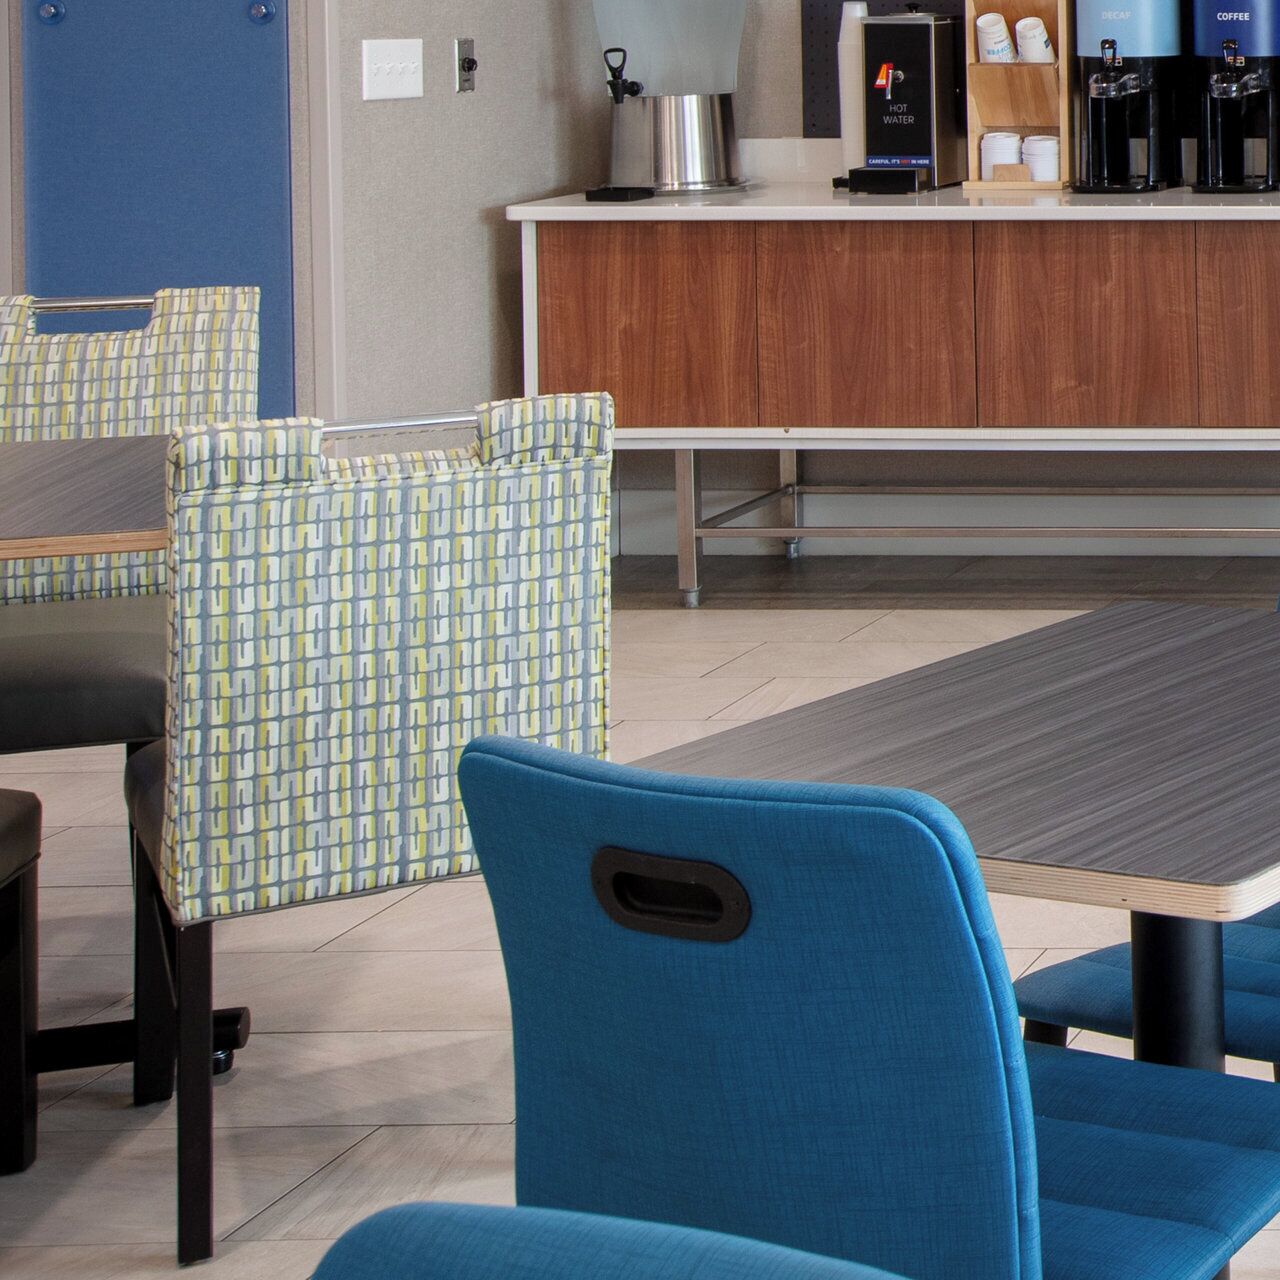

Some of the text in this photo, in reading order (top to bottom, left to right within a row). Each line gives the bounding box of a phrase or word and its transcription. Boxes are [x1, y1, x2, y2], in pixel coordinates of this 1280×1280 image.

[1102, 11, 1131, 20] DECAF
[1217, 12, 1250, 21] COFFEE
[889, 103, 908, 113] HOT
[883, 116, 915, 125] WATER
